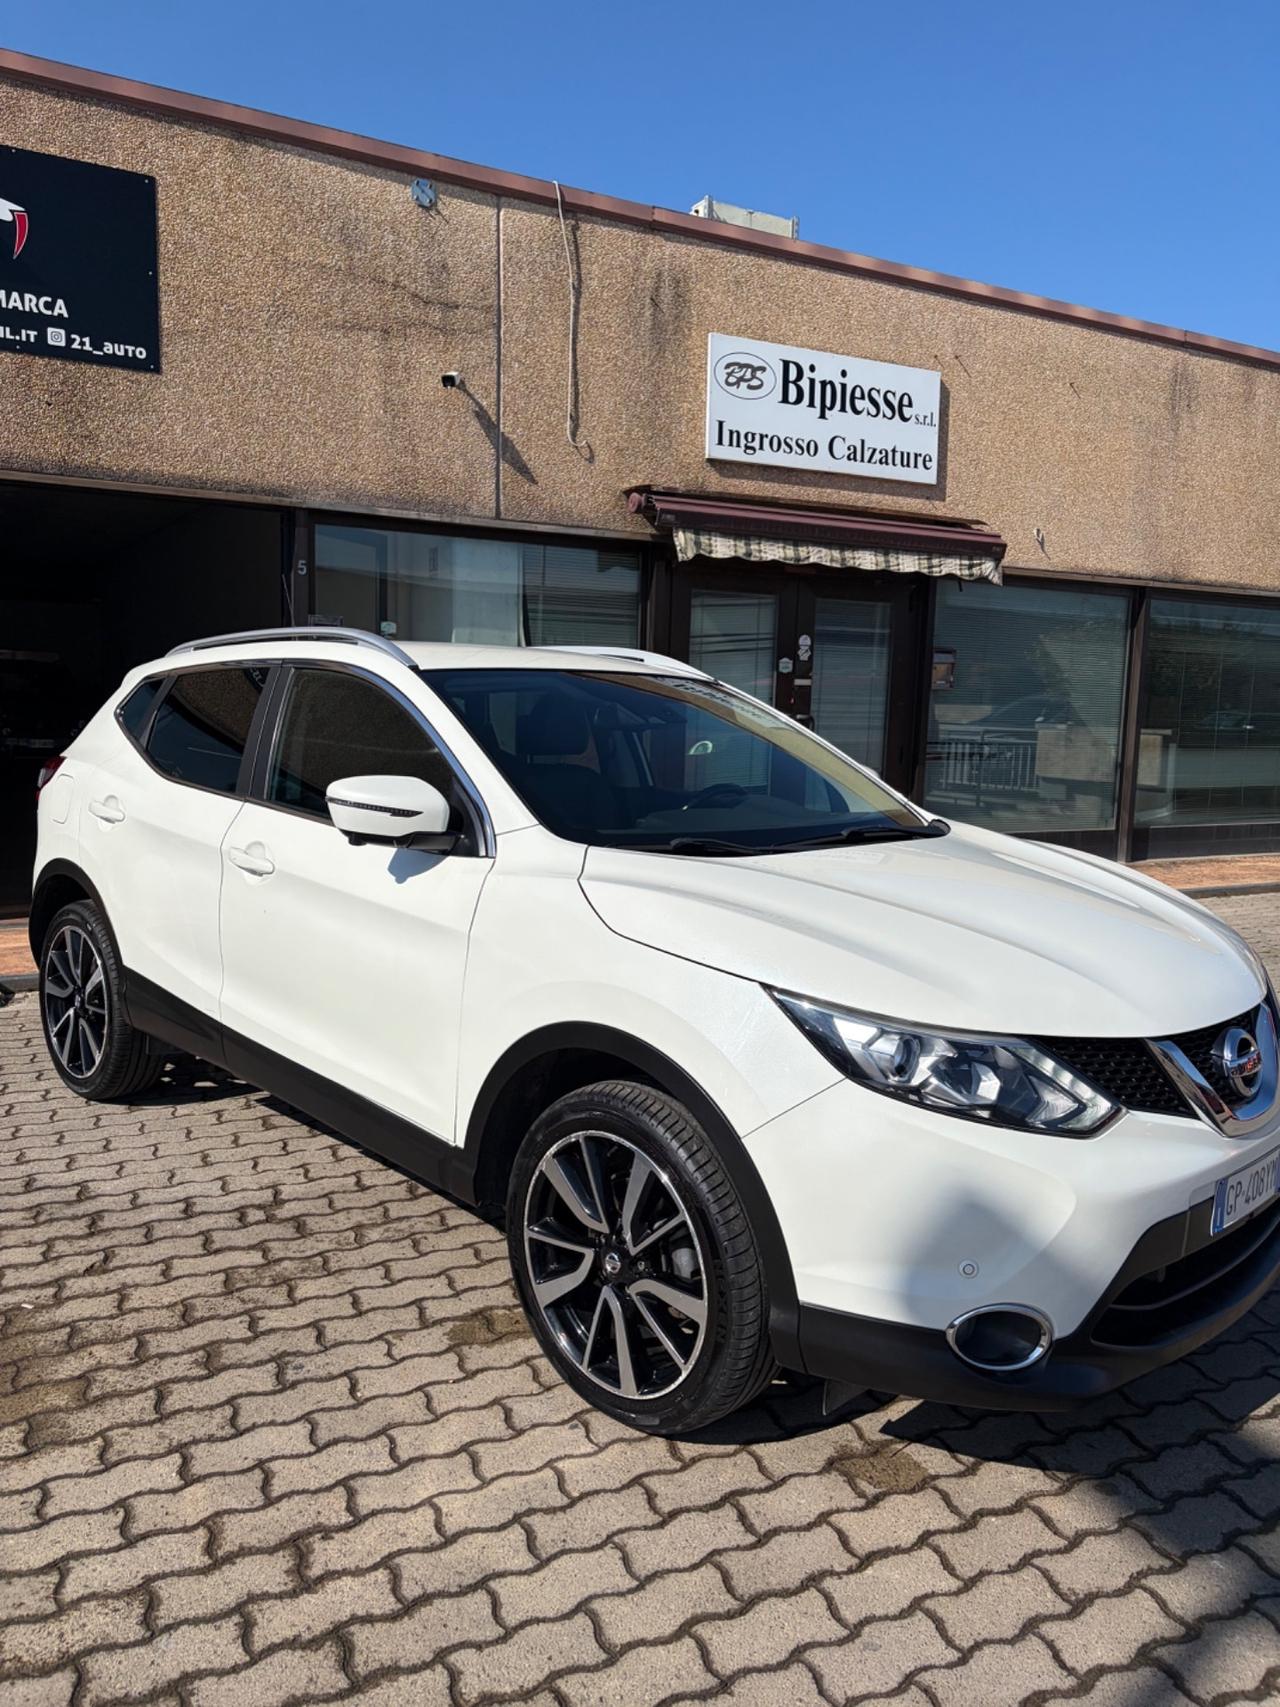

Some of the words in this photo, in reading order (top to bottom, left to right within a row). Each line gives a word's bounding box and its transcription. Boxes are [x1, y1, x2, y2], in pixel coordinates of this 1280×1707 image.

[777, 358, 913, 423] Bipiesse
[715, 419, 819, 457] Ingrosso
[828, 434, 933, 471] Calzature
[297, 559, 307, 575] 5
